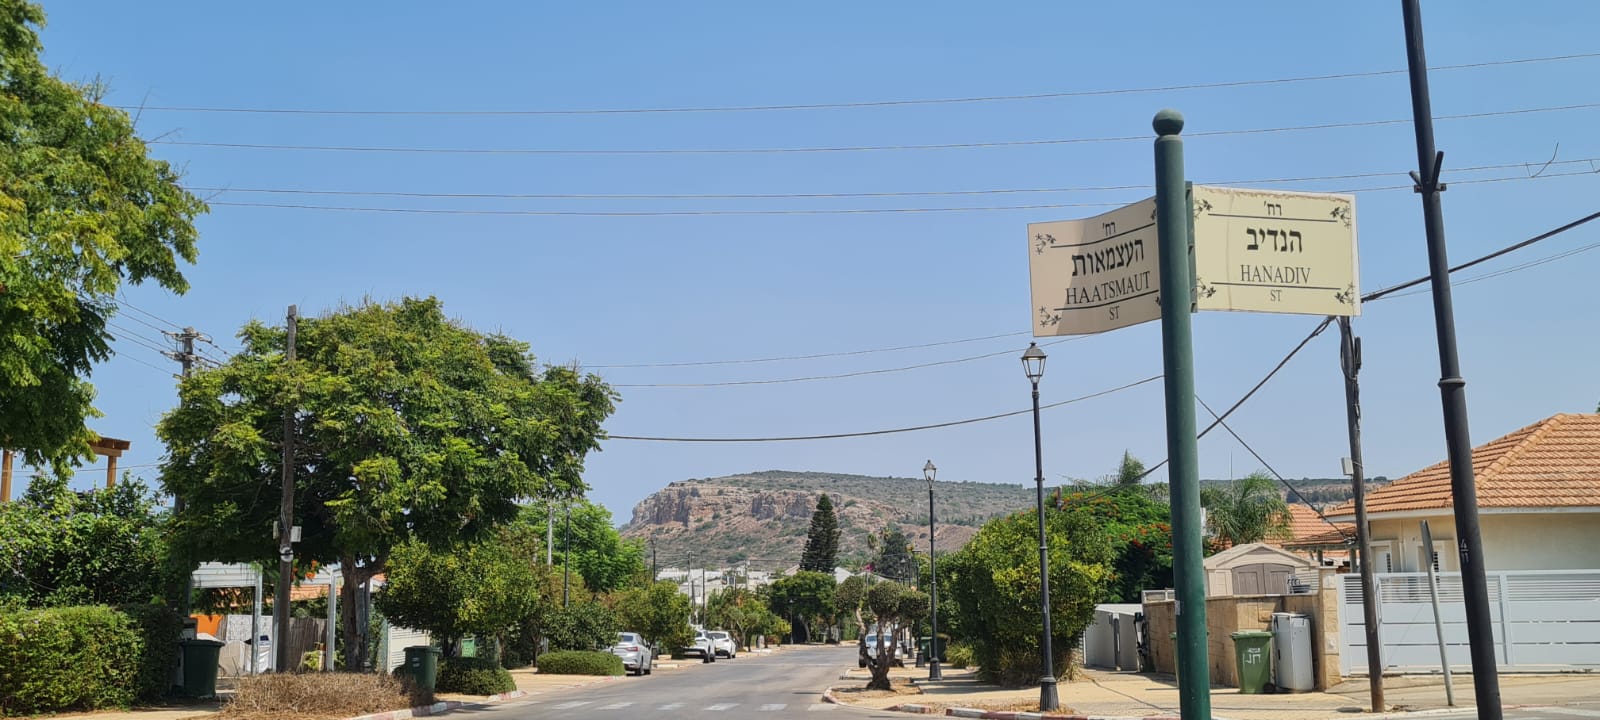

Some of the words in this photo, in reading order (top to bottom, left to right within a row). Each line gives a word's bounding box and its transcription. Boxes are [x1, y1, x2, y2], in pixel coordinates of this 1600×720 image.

[1263, 200, 1282, 217] רח'
[1102, 221, 1117, 238] רח'
[1246, 227, 1303, 253] הנדיב
[1071, 239, 1145, 277] העצמאות
[1240, 264, 1311, 285] HANADIV
[1065, 270, 1151, 305] HAATSMAUT
[1269, 289, 1283, 302] ST
[1109, 305, 1120, 321] ST
